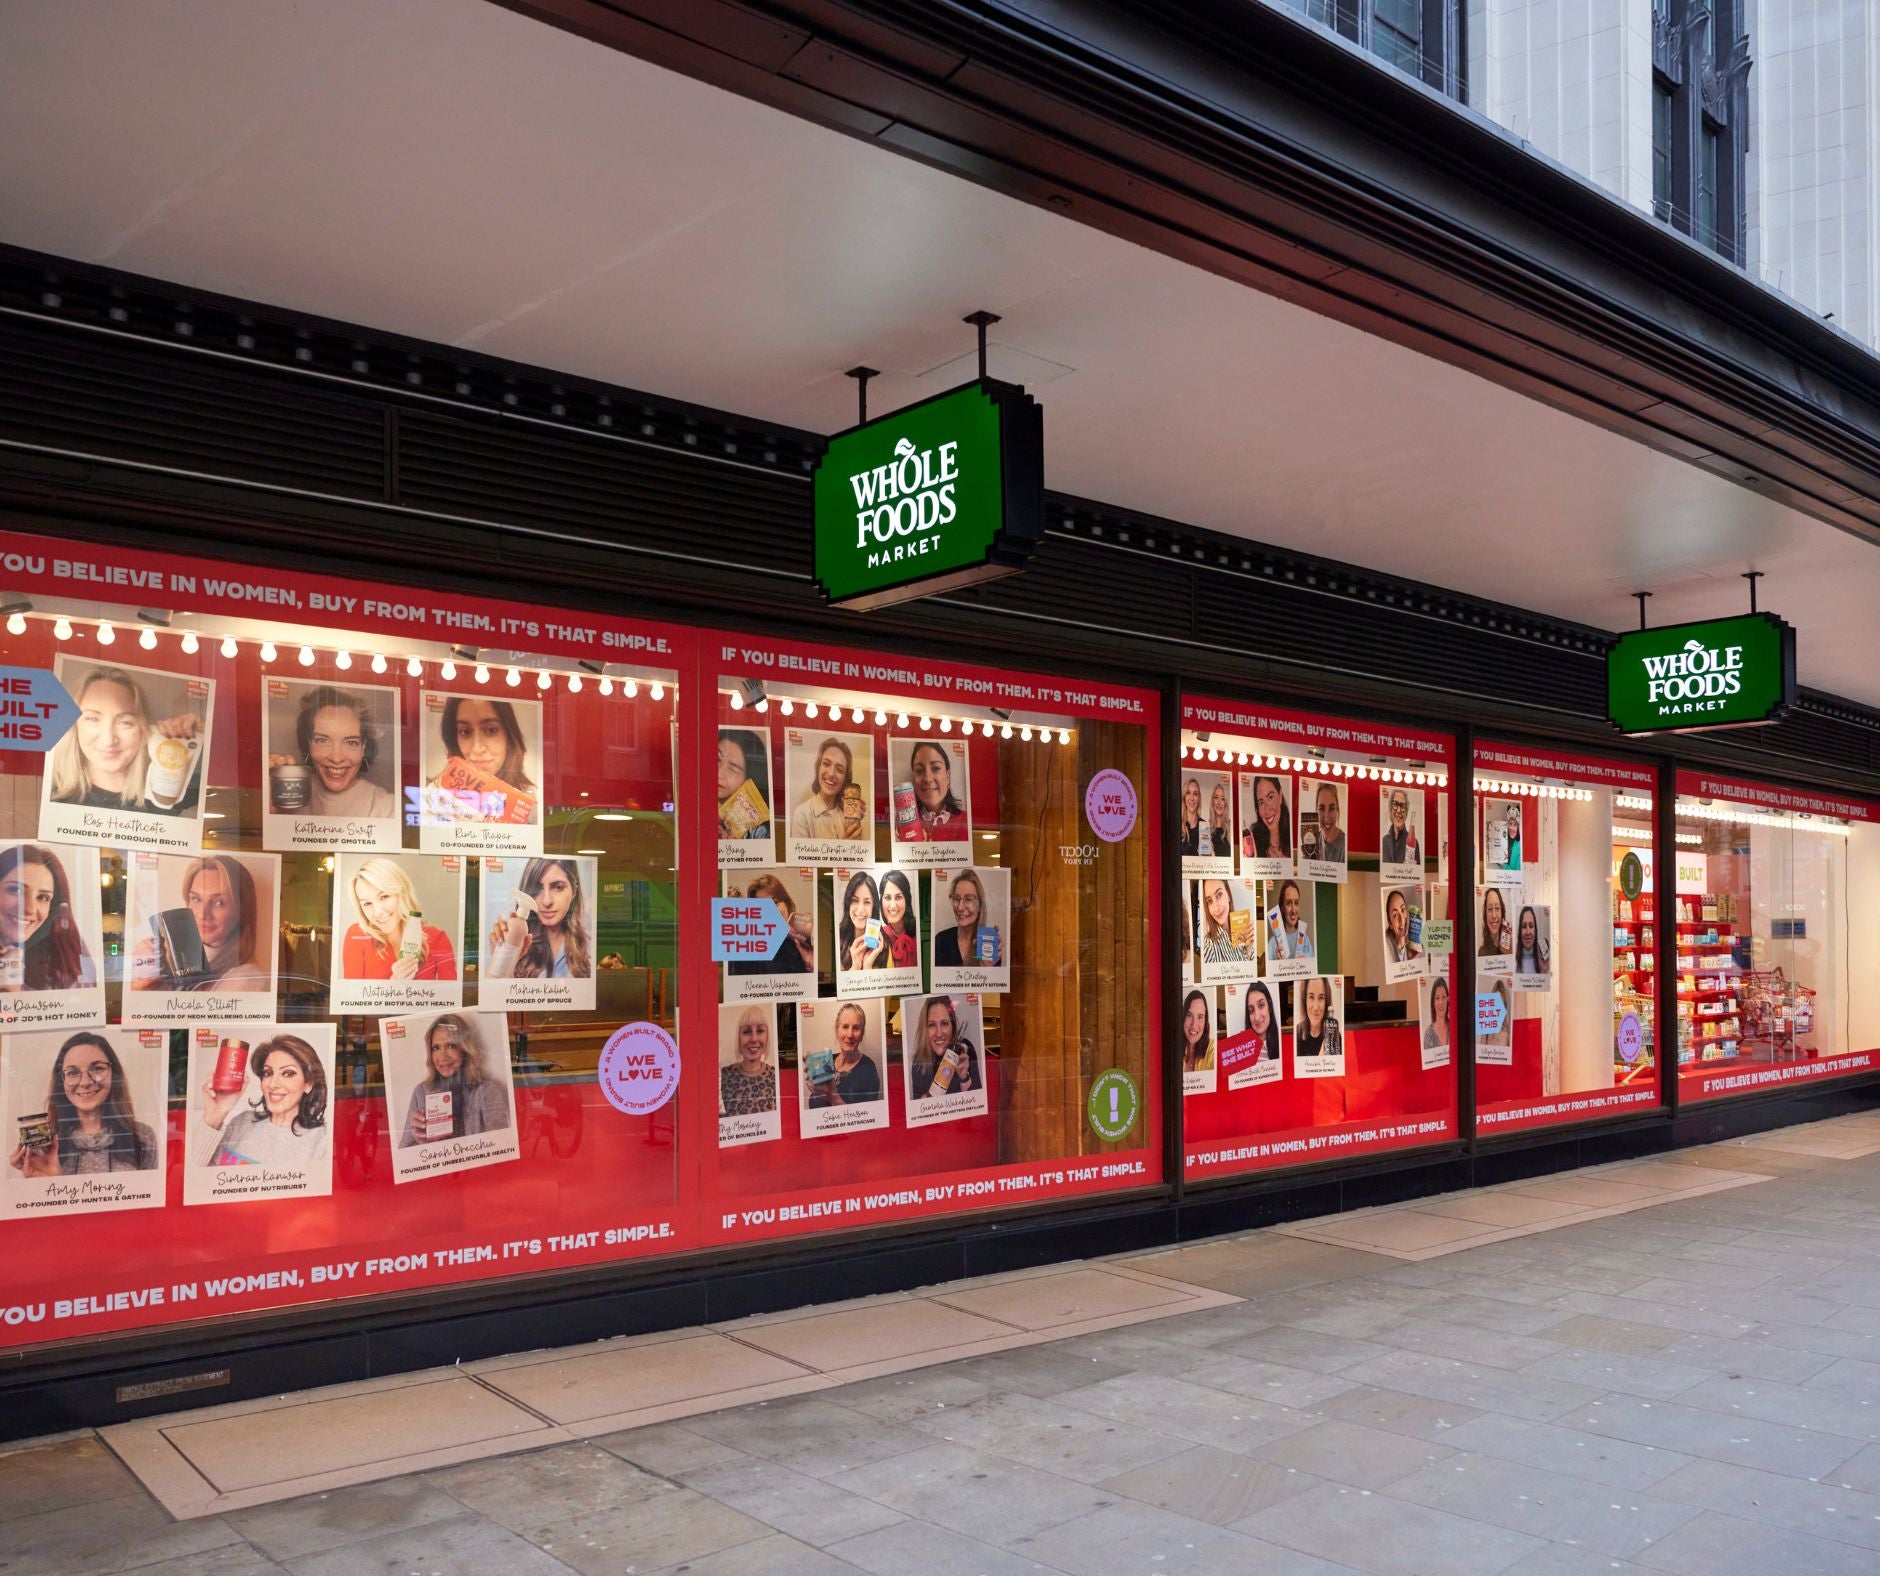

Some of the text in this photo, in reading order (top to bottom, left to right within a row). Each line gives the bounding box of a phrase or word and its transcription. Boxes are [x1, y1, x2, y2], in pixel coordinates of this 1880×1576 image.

[850, 440, 959, 510] WHOLE
[856, 483, 957, 549] FOODS
[868, 535, 941, 569] MARKET
[53, 559, 163, 590] BELIEVE
[171, 574, 196, 594] IN
[203, 578, 303, 610] WOMEN,
[309, 592, 358, 613] BUY
[364, 600, 426, 623] FROM
[431, 609, 496, 632] THEM.
[501, 618, 540, 637] IT'S
[545, 624, 597, 644] THAT
[602, 631, 672, 654] SIMPLE.
[1642, 646, 1743, 680] WHOLE
[0, 678, 32, 695] HE
[722, 646, 1143, 712] IF YOU BELIEVE IN WOMEN, BUY FROM THEM. IT'S THAT SIMPLE.
[1648, 671, 1741, 703] FOODS
[0, 700, 58, 719] UILT
[1659, 700, 1727, 716] MARKET
[0, 722, 42, 740] HIS
[1102, 794, 1122, 804] WE
[107, 816, 167, 833] Heathcote
[294, 820, 377, 838] Katherine Swift
[57, 827, 99, 837] FOUNDER
[115, 834, 157, 844] BOROUGH
[159, 838, 188, 847] BROTH
[1679, 866, 1703, 881] BUILT
[721, 907, 762, 920] SHE
[721, 924, 776, 936] BUILT
[723, 941, 768, 953] THIS
[362, 985, 404, 998] Natasha
[13, 999, 64, 1013] Dawson
[166, 998, 204, 1011] Nicola
[1479, 999, 1495, 1008] SHE
[21, 1015, 43, 1023] JD'S
[45, 1013, 64, 1021] HOT
[66, 1011, 98, 1019] HONEY
[1479, 1009, 1501, 1018] BUILT
[1479, 1020, 1498, 1029] THIS
[1236, 1040, 1256, 1053] WHAT
[626, 1055, 655, 1067] WE
[1482, 1113, 1496, 1124] YOU
[1497, 1109, 1524, 1122] BELIEVE
[1524, 1108, 1532, 1118] IN
[1532, 1104, 1557, 1116] WOMEN,
[1558, 1102, 1571, 1112] BUY
[1571, 1100, 1588, 1110] FROM
[1589, 1098, 1607, 1107] THEM.
[1607, 1096, 1618, 1105] IT'S
[1619, 1093, 1634, 1103] THAT
[1635, 1091, 1655, 1101] SIMPLE.
[1186, 1120, 1447, 1167] IF YOU BELIEVE IN WOMEN, BUY FROM THEM. IT'S THAT SIMPLE.
[400, 1164, 431, 1175] FOUNDER
[492, 1147, 515, 1156] HEALTH
[420, 1148, 452, 1163] Sarah
[216, 1169, 305, 1186] Simran Kanwar
[45, 1180, 125, 1199] Amy Moring
[212, 1187, 248, 1195] FOUNDER
[261, 1183, 307, 1192] NUTRIBURST
[723, 1161, 1146, 1229] IF YOU BELIEVE IN WOMEN, BUY FROM THEM. IT'S THAT SIMPLE.
[16, 1199, 68, 1209] CO-FOUNDER
[81, 1196, 113, 1204] HUNTER
[121, 1193, 151, 1201] GATHER
[54, 1287, 165, 1319] BELIEVE
[172, 1282, 197, 1302] IN
[205, 1269, 304, 1297] WOMEN,
[311, 1261, 360, 1283] BUY
[366, 1253, 428, 1276] FROM
[433, 1245, 498, 1267] THEM.
[503, 1239, 542, 1258] IT'S
[547, 1231, 600, 1252] THAT
[604, 1222, 675, 1244] SIMPLE.
